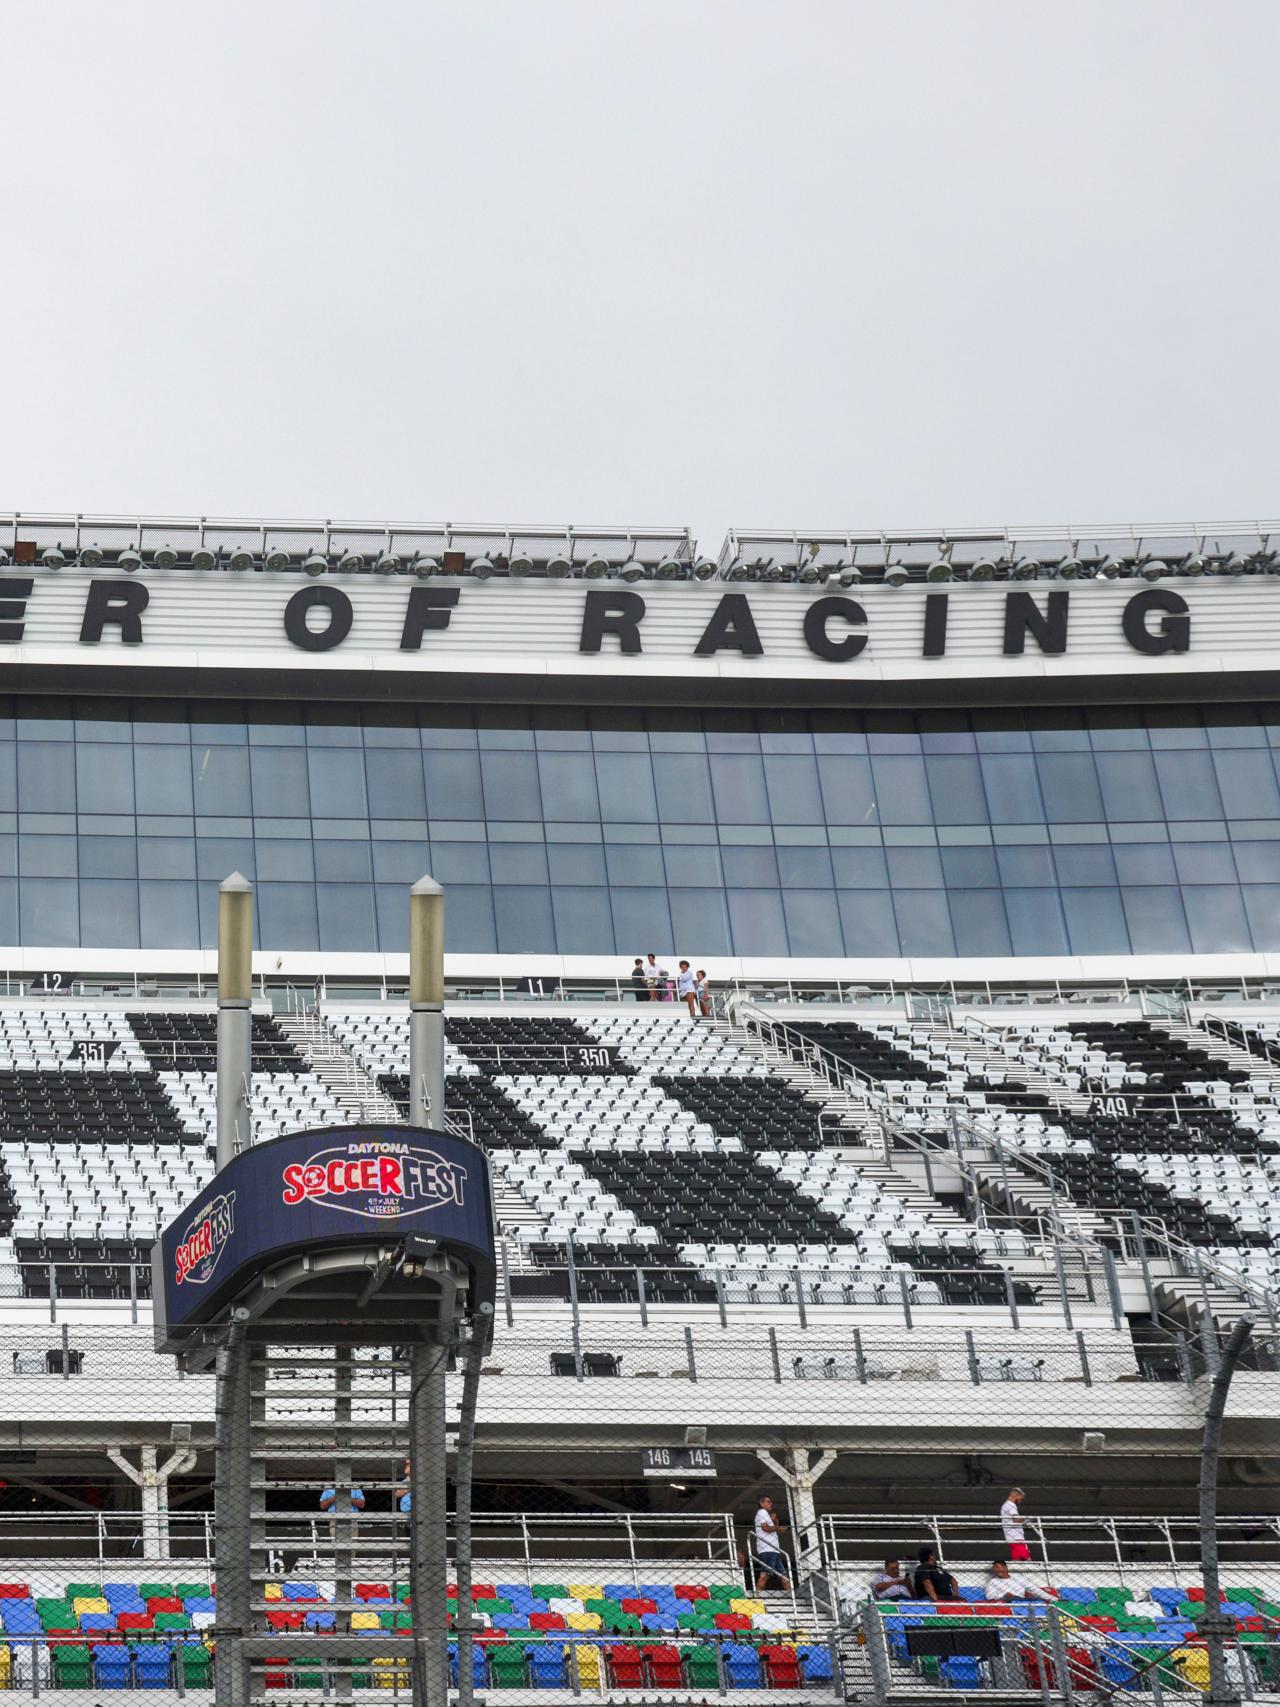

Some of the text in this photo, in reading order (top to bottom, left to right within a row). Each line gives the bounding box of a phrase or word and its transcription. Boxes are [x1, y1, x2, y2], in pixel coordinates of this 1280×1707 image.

[284, 585, 461, 652] OF
[580, 589, 1190, 662] RACING
[43, 973, 62, 992] L2
[528, 979, 544, 997] L1
[78, 1042, 105, 1061] 351
[579, 1048, 610, 1066] 350
[1093, 1096, 1129, 1118] 349
[348, 1143, 410, 1155] DAYTONA
[368, 1205, 401, 1215] WEEKEND
[647, 1448, 711, 1466] 146 145
